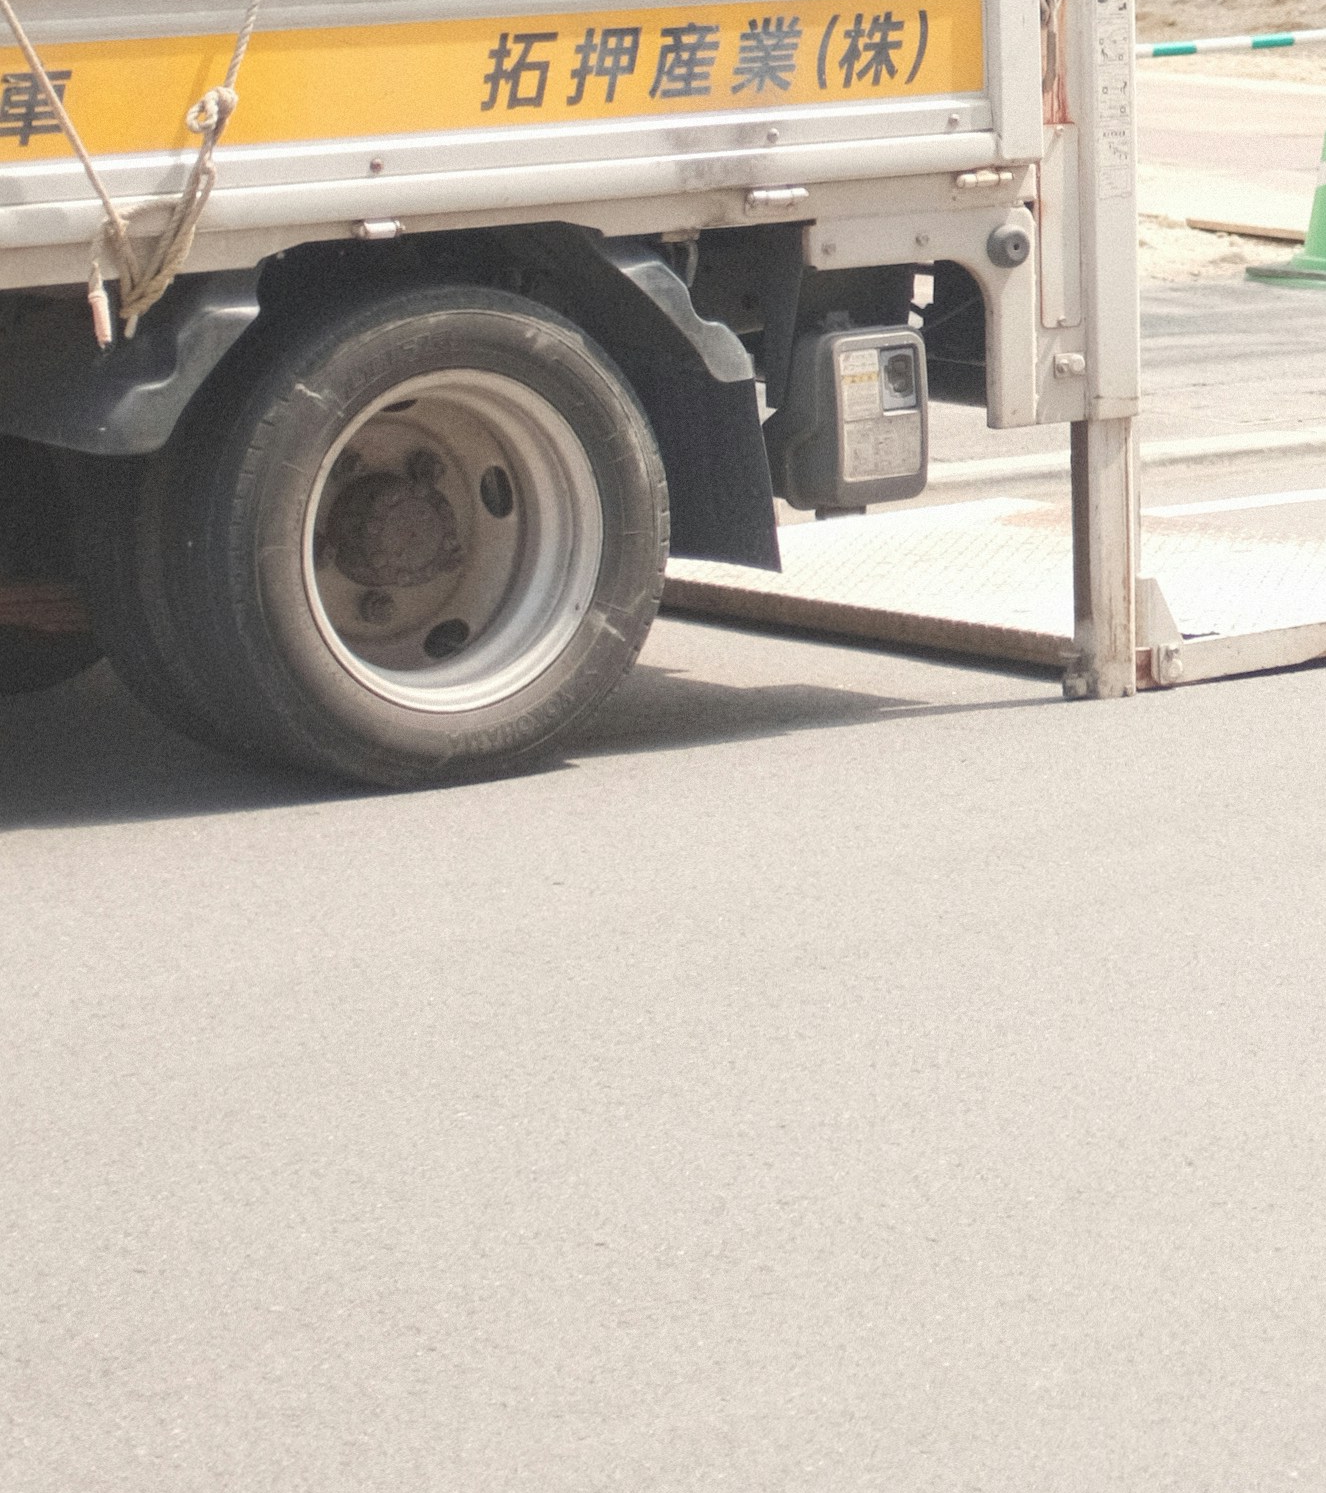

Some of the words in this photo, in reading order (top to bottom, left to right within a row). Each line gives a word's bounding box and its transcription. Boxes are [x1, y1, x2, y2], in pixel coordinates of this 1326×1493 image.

[479, 9, 929, 113] 拓押産業(株)
